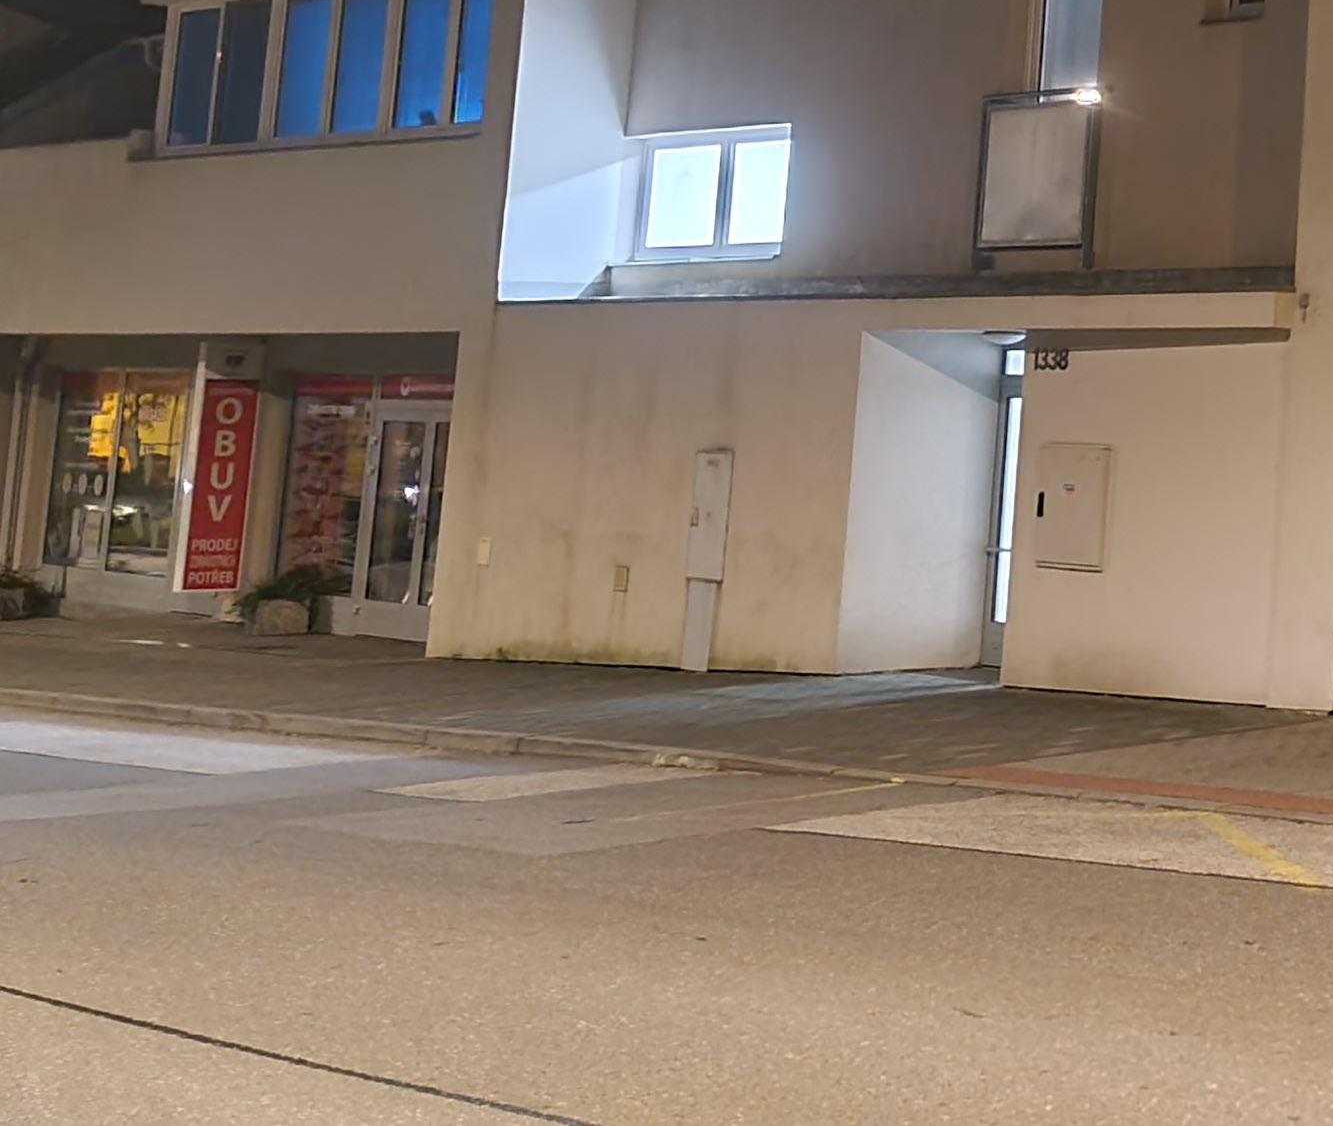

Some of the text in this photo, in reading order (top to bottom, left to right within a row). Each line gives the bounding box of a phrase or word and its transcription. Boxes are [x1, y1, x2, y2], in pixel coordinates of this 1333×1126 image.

[1034, 348, 1070, 371] 1338
[207, 397, 243, 522] OBUV
[191, 538, 238, 552] PRODEJ
